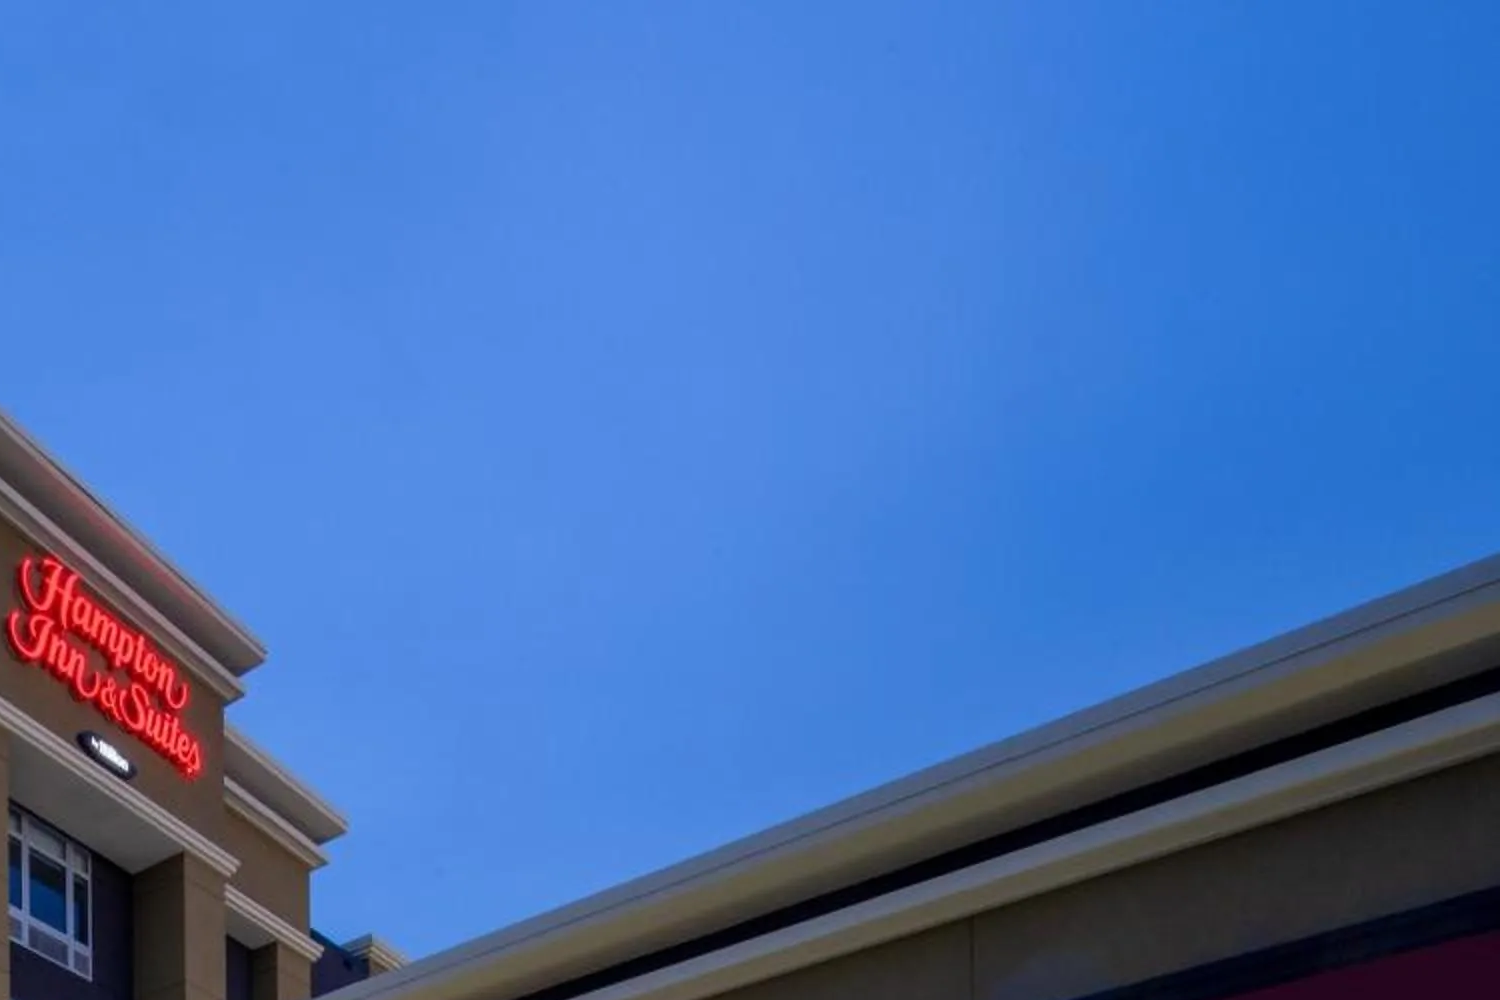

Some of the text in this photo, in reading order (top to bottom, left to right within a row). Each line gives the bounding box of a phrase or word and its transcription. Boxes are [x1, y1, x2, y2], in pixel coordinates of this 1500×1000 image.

[7, 609, 101, 699] Inn
[100, 676, 122, 722] &
[119, 683, 203, 775] Suites
[19, 556, 190, 710] Hampton
